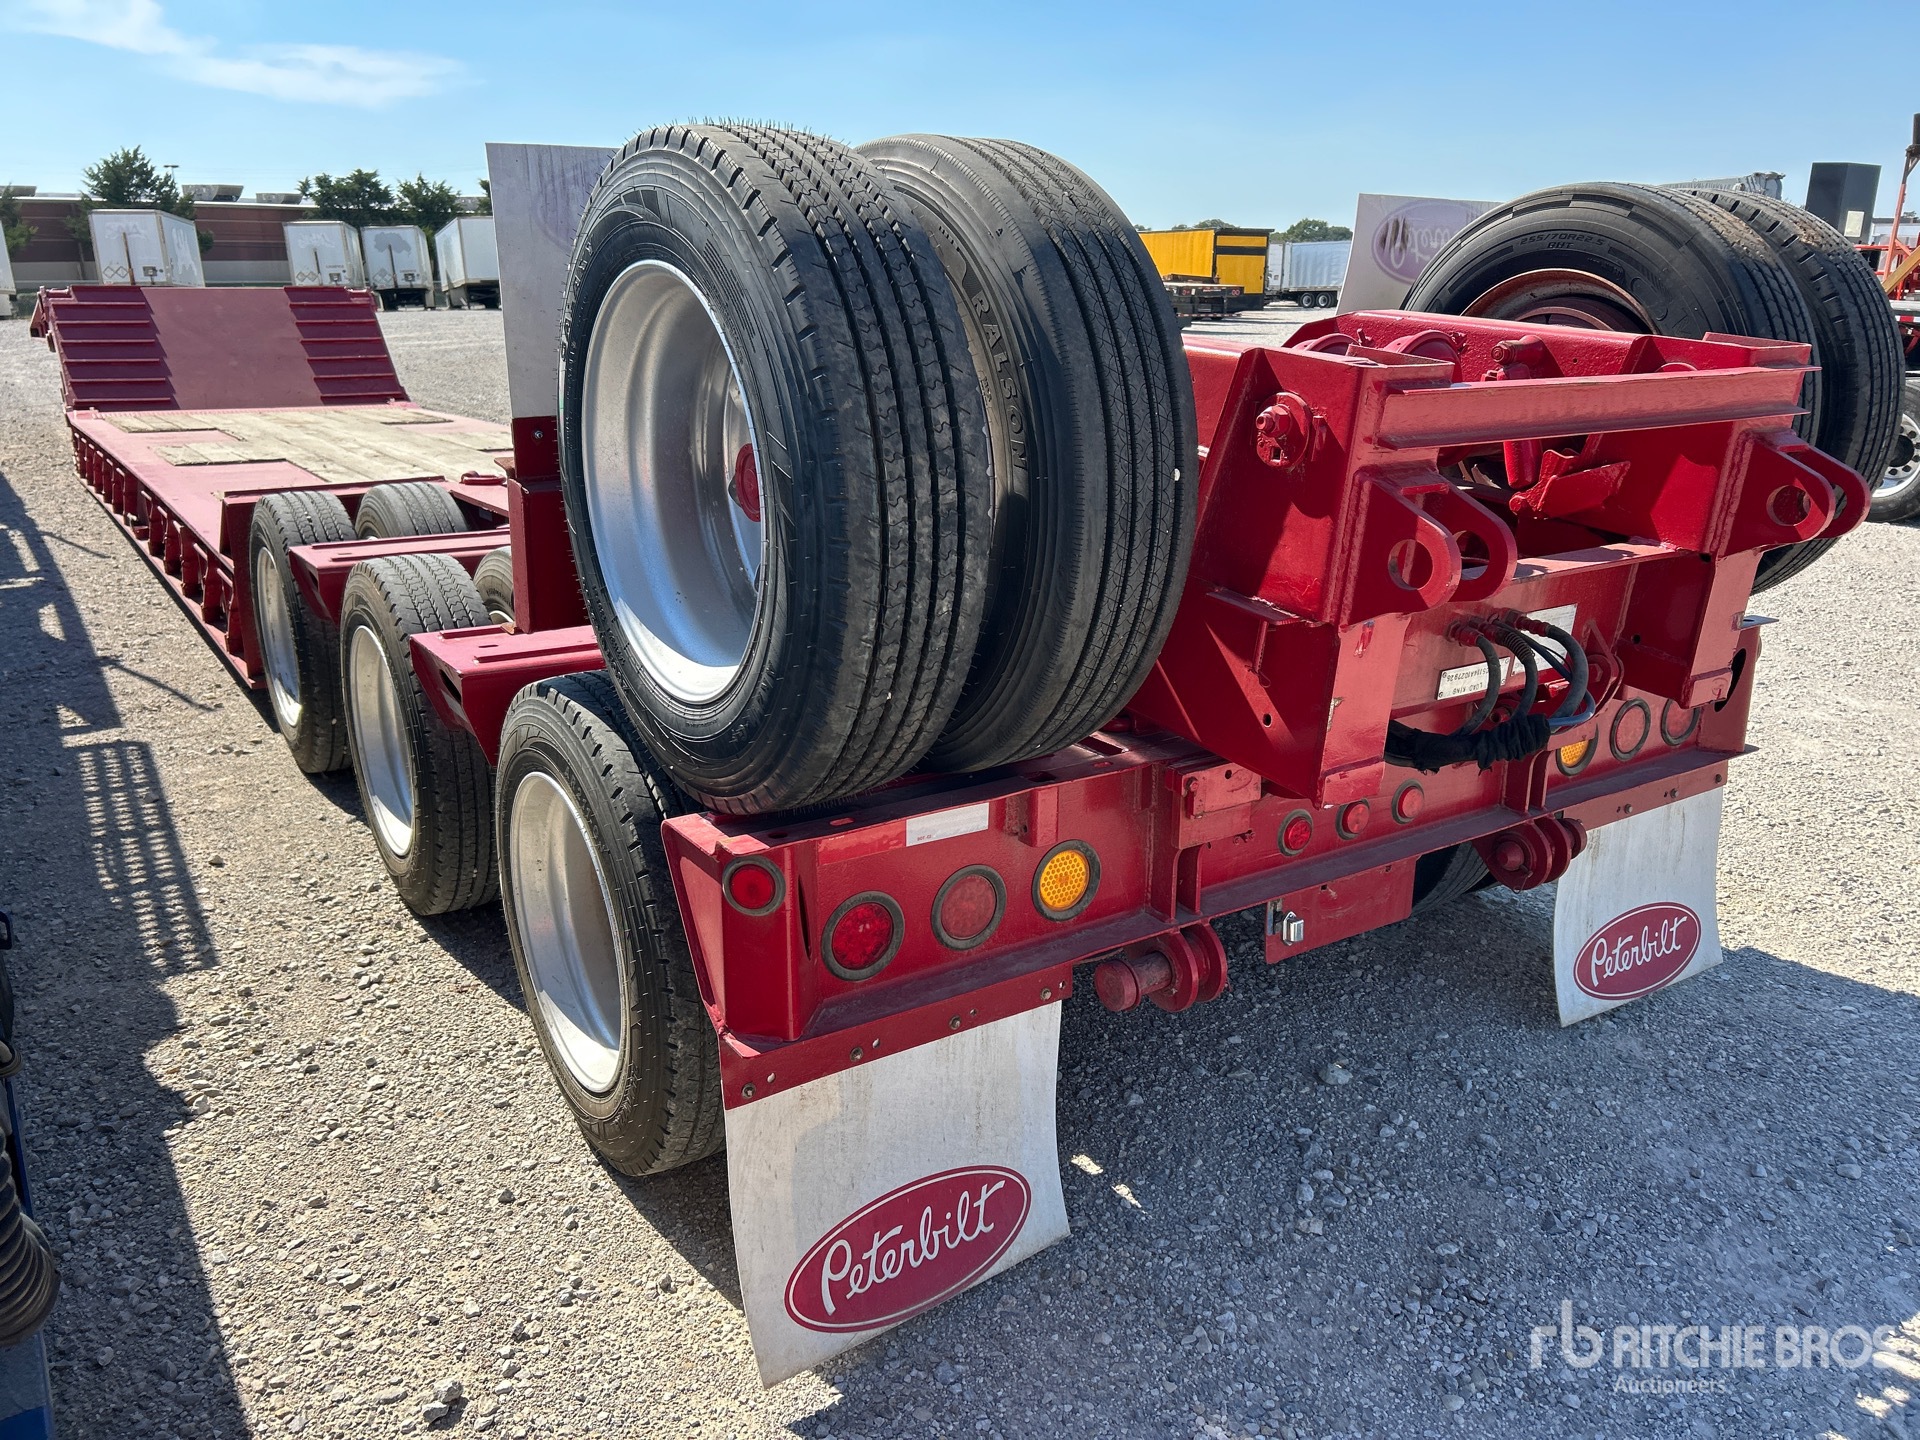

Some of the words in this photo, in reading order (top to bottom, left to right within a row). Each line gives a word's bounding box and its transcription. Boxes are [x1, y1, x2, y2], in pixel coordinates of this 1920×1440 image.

[971, 289, 1029, 472] RALSON
[1590, 916, 1688, 987] Peterbilt
[821, 1180, 1006, 1316] Peterbilt
